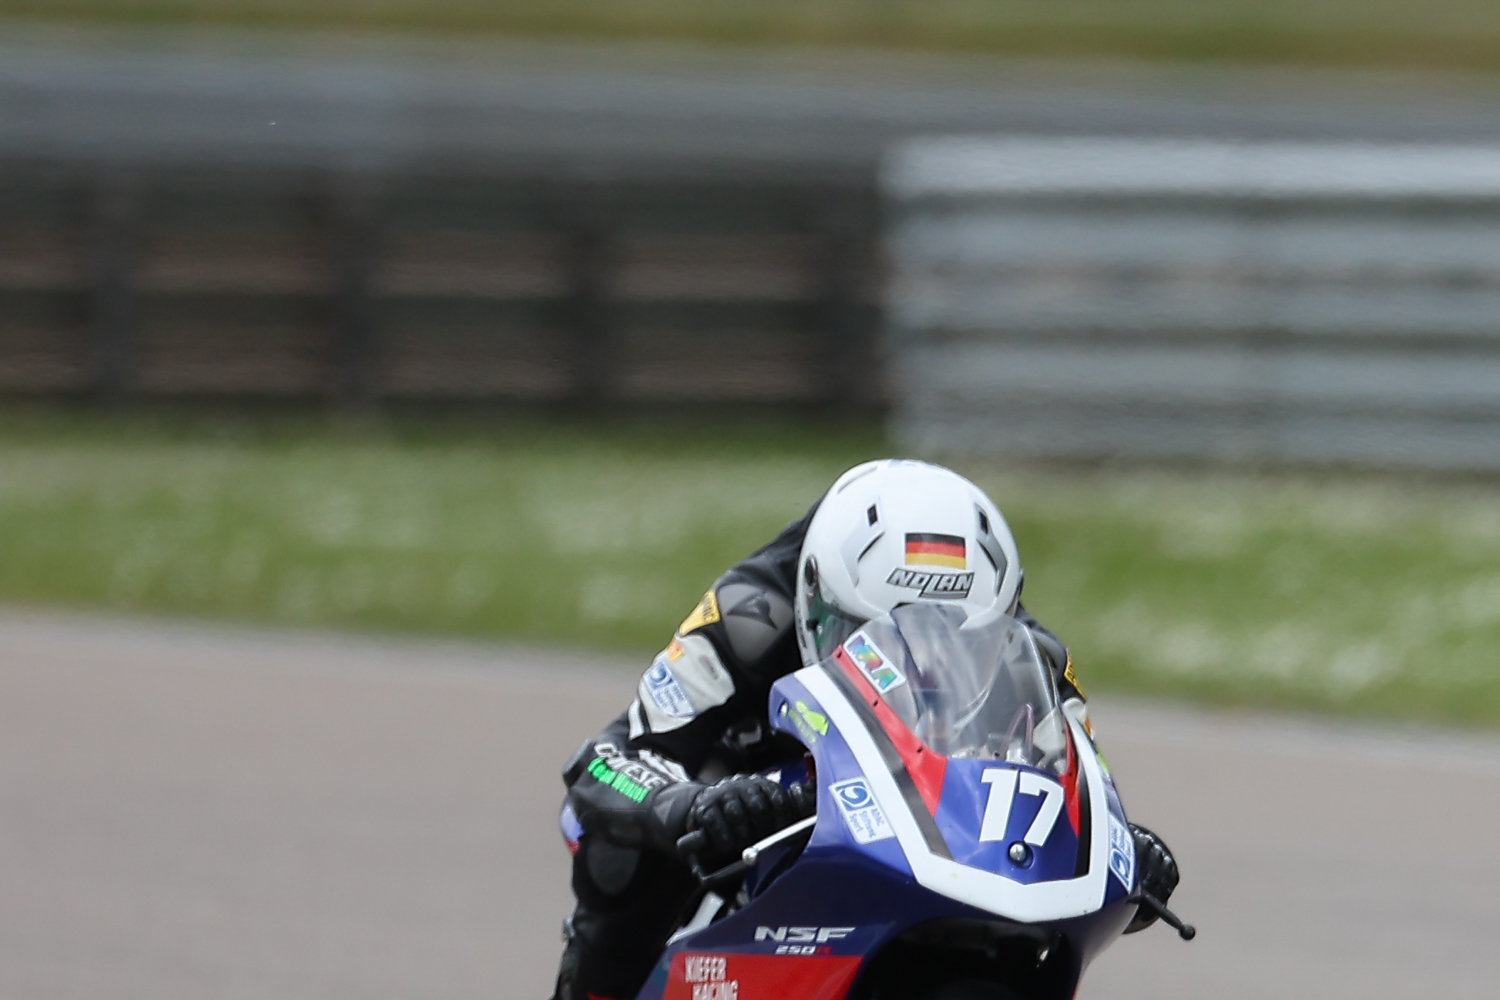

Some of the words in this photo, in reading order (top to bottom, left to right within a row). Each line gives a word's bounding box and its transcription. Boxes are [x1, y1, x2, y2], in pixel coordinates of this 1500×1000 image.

[886, 568, 974, 599] NOLAN
[846, 634, 898, 690] MRA
[979, 768, 1065, 847] 17
[754, 926, 856, 943] NSF
[685, 956, 727, 983] KIEFER
